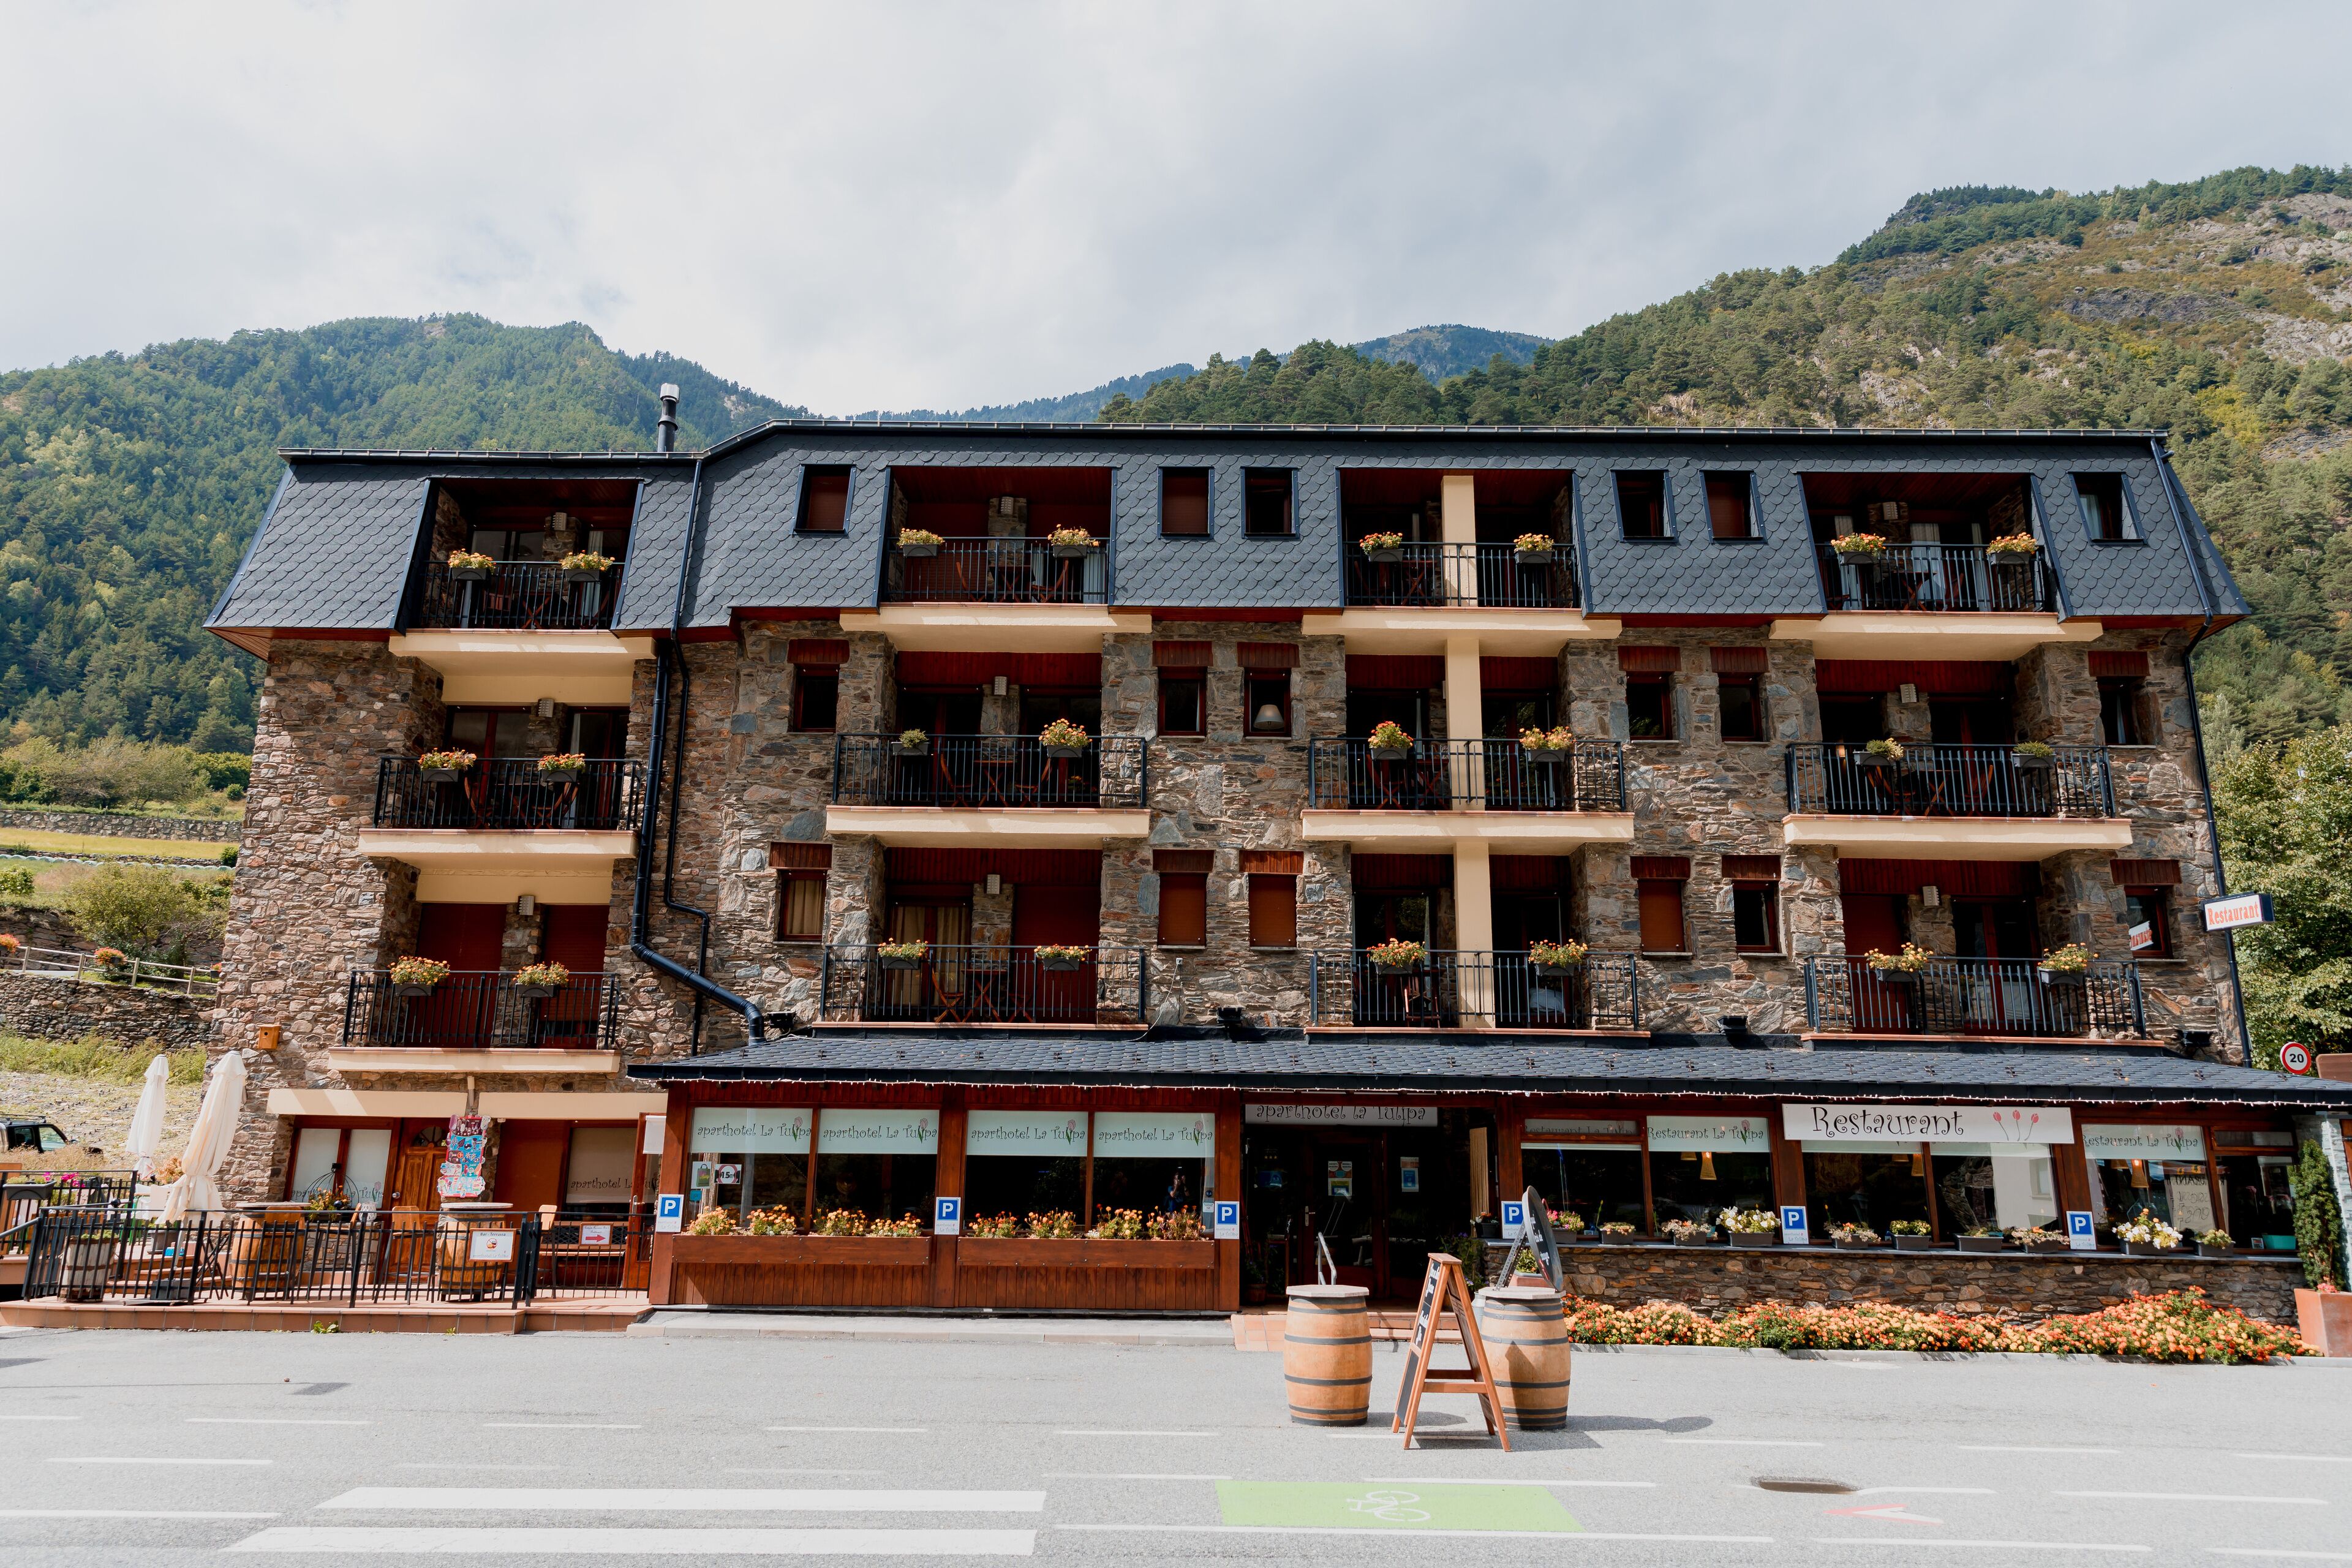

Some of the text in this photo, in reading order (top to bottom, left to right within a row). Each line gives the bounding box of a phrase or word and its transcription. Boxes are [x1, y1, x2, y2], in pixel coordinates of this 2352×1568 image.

[2207, 902, 2259, 925] Restaurant
[2290, 1054, 2304, 1063] 20
[1257, 1105, 1346, 1122] aparthotel
[1811, 1107, 1964, 1138] Restaurant
[698, 1123, 812, 1139] aparthotel La Tulipa
[823, 1125, 937, 1140] aparthotel La Tulipa
[971, 1126, 1085, 1142] aparthotel La Tulipa
[1099, 1127, 1213, 1143] aparthotel La Tulipa
[1648, 1126, 1763, 1142] Restaurant La Tulipa
[2146, 1135, 2158, 1147] La
[2163, 1134, 2198, 1150] Tulipa
[571, 1178, 620, 1191] aparthotel
[625, 1178, 632, 1188] L
[665, 1200, 676, 1214] P
[942, 1202, 954, 1217] P
[1221, 1207, 1232, 1221] P
[1509, 1207, 1520, 1221] P
[1789, 1212, 1800, 1226] P
[2075, 1216, 2086, 1231] P
